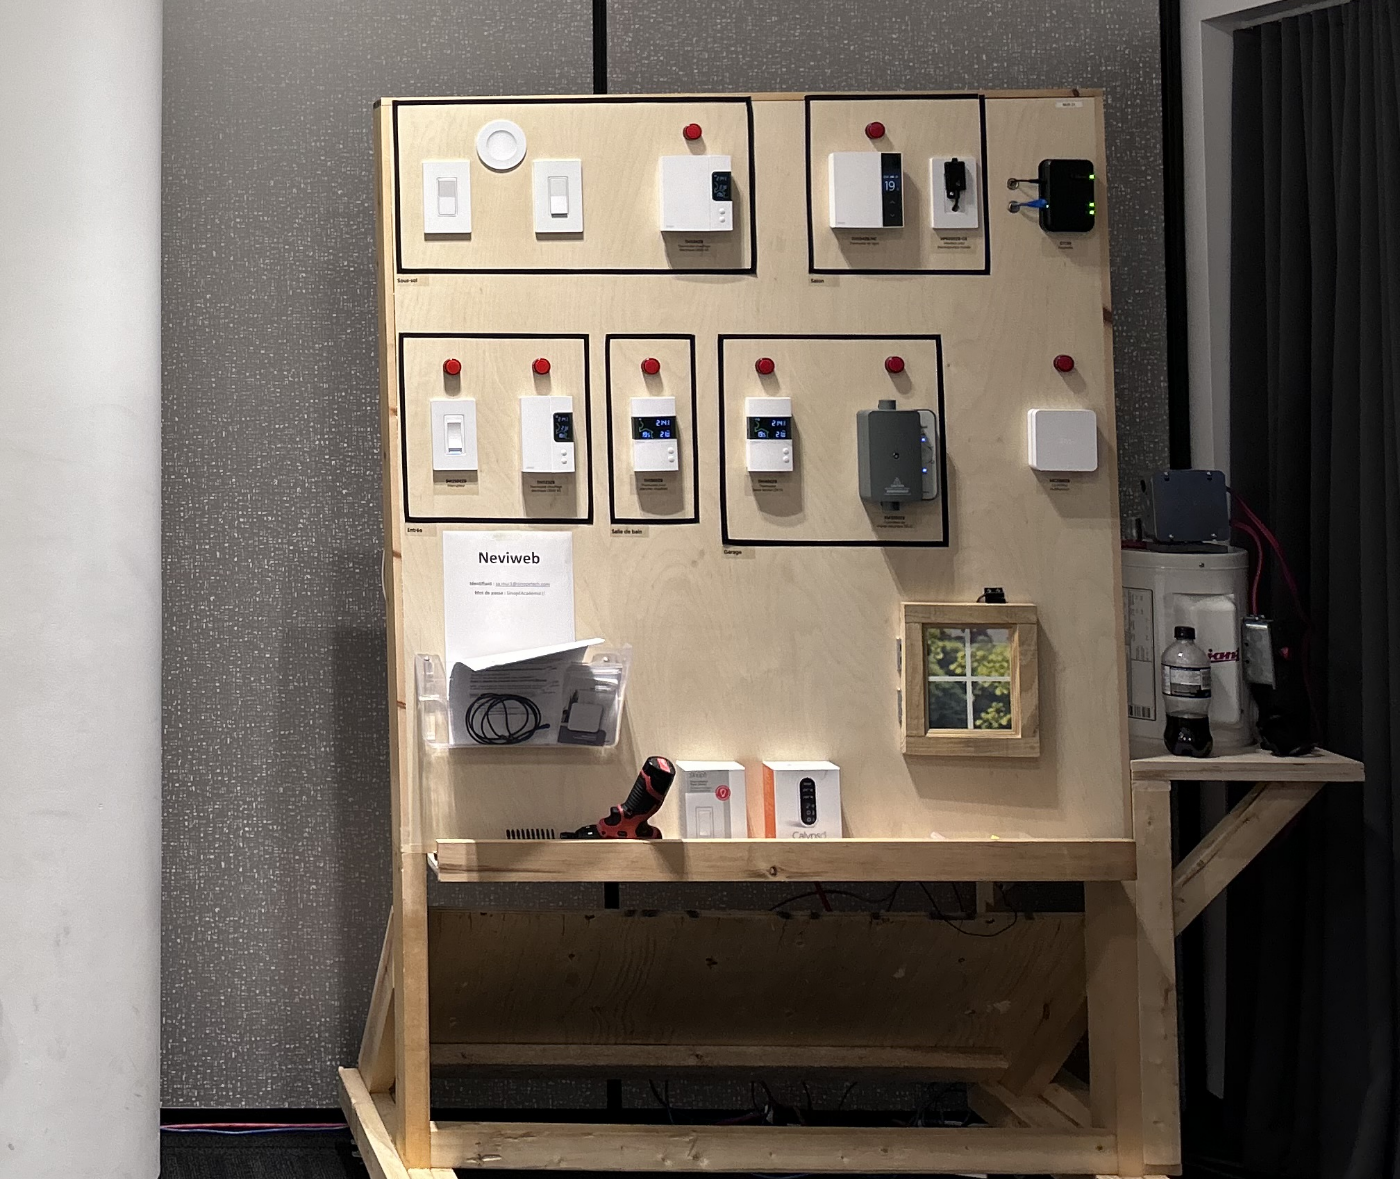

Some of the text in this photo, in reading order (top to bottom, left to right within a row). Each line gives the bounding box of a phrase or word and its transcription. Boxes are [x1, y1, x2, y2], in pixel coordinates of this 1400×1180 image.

[884, 180, 895, 191] 19
[478, 552, 540, 564] Neviweb
[1208, 647, 1239, 663] iant
